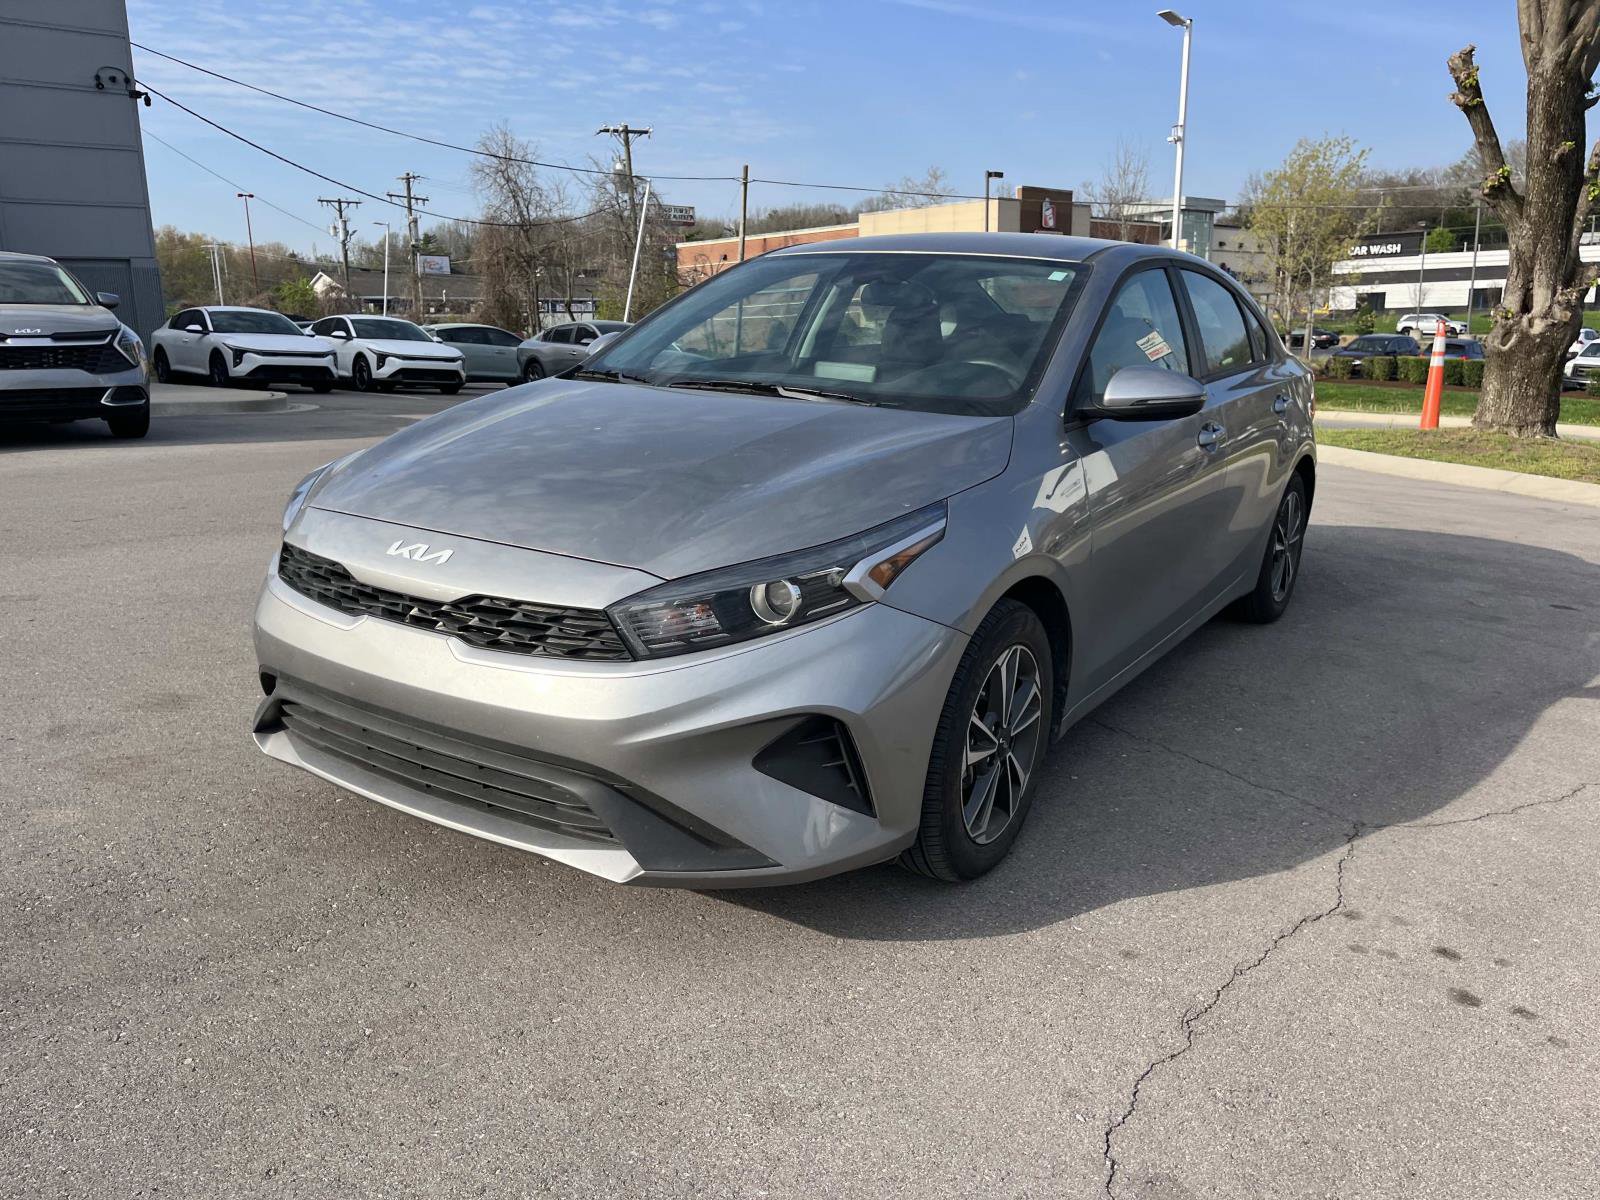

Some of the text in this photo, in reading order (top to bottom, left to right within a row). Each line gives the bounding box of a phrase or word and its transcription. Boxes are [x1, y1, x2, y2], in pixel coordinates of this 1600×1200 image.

[1348, 244, 1401, 256] CAR WASH
[386, 539, 454, 565] KIA
